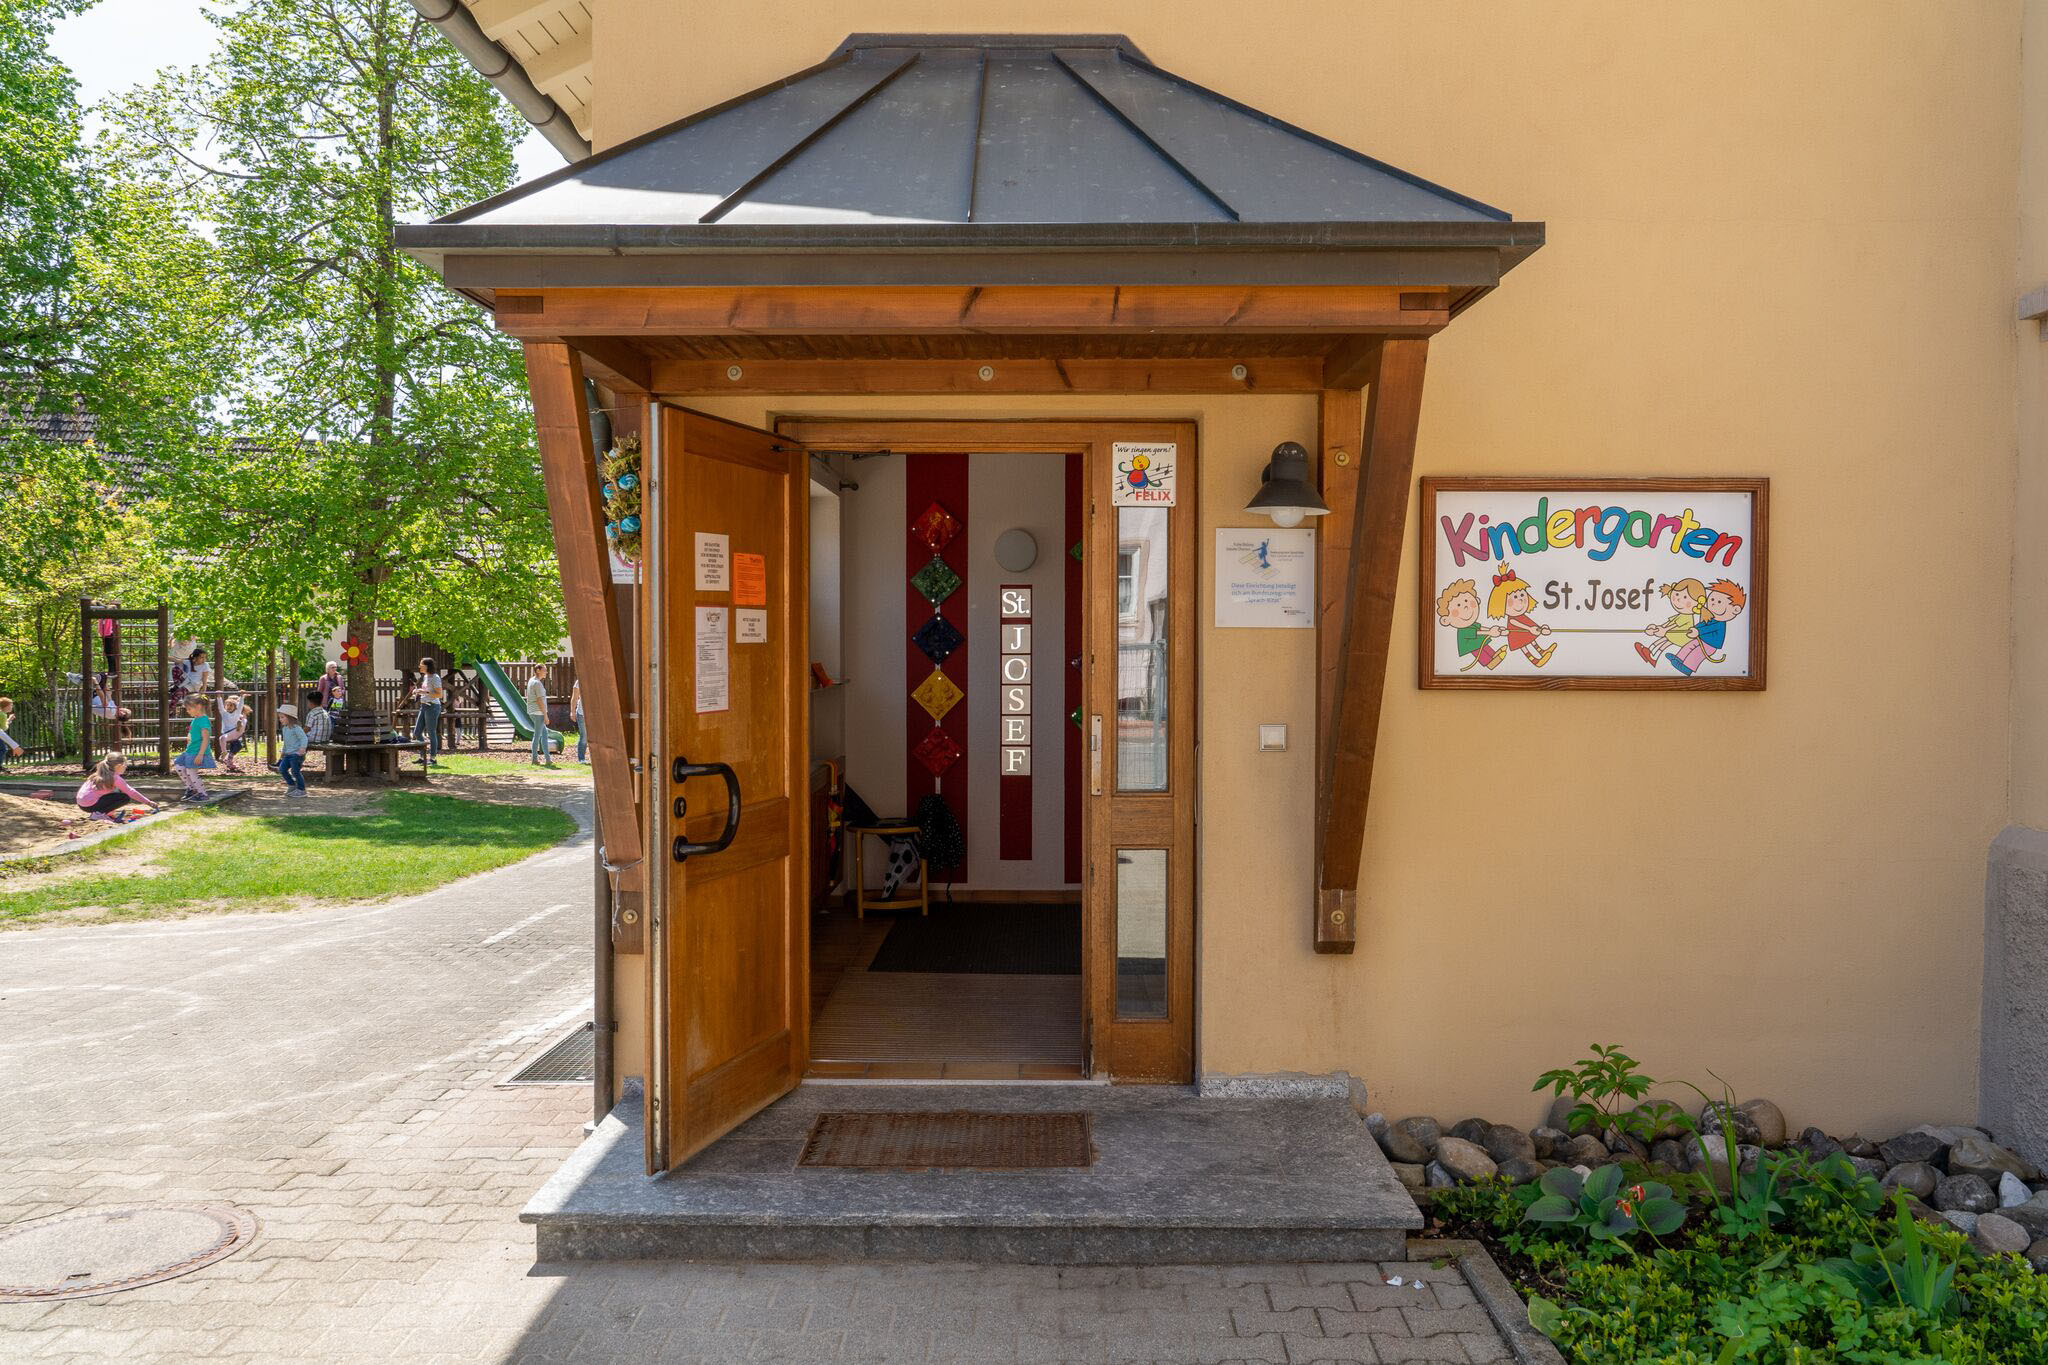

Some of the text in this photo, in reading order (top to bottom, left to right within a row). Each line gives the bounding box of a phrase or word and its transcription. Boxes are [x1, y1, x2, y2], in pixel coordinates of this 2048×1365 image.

[1131, 446, 1152, 456] singen
[1135, 490, 1171, 501] FELIX
[1440, 496, 1743, 568] Kindergarten
[1002, 591, 1030, 615] St.
